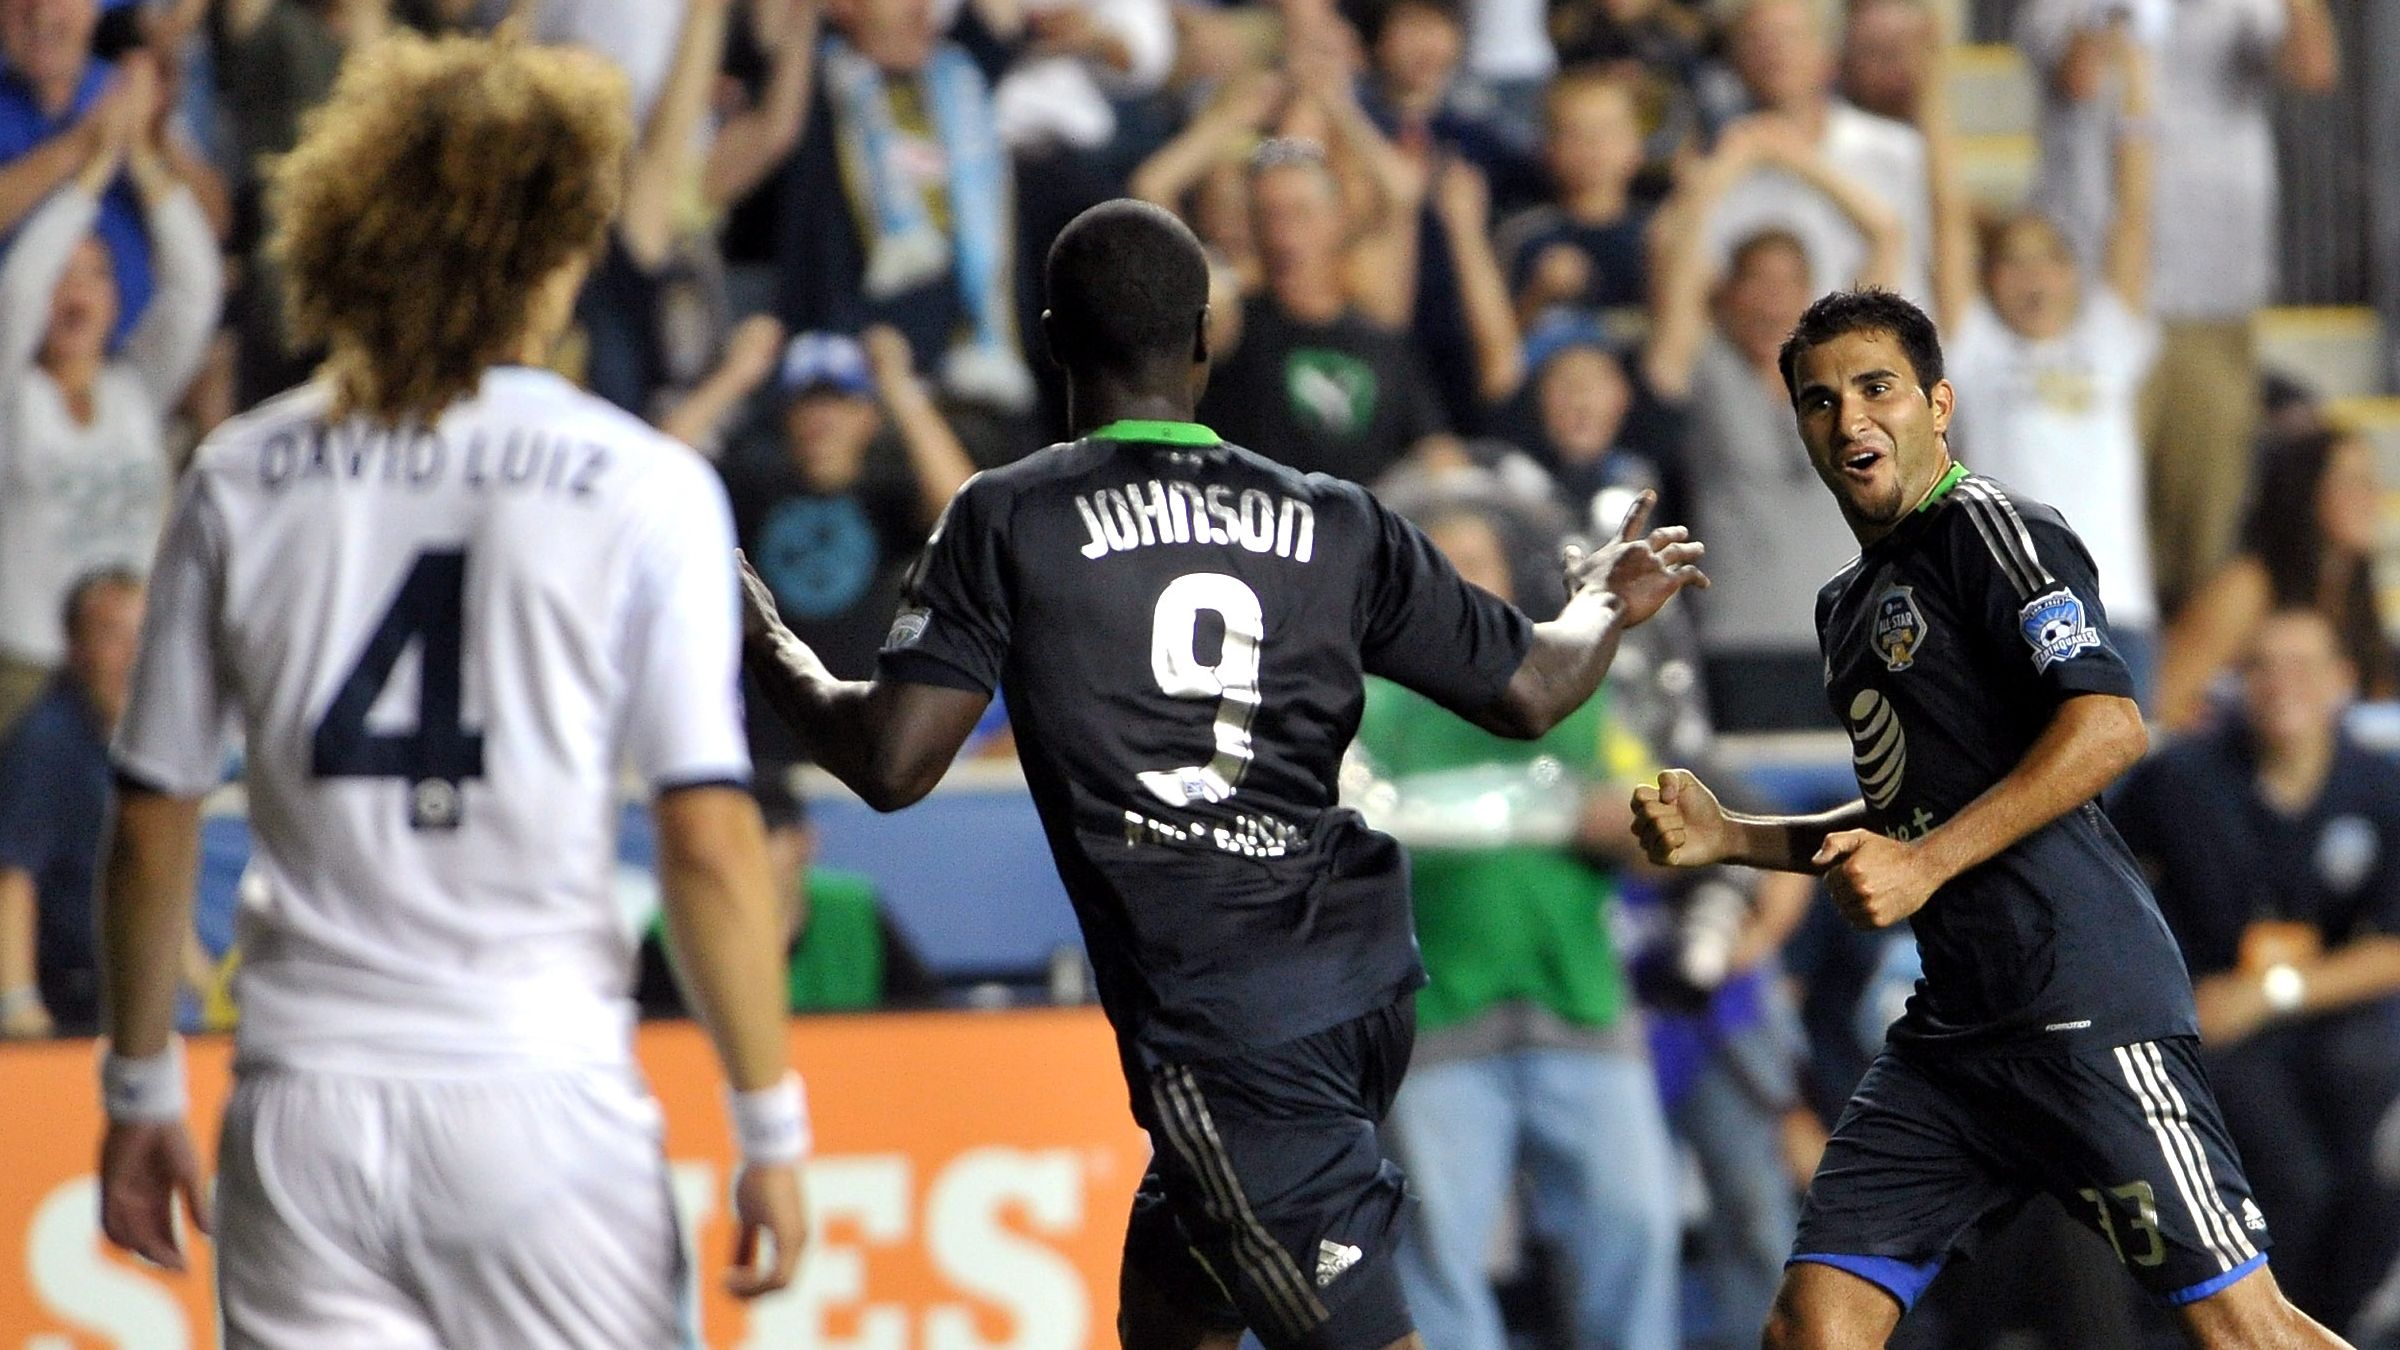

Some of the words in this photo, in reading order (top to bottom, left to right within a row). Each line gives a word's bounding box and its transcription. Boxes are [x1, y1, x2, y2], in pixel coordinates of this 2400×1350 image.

[259, 424, 447, 494] DAVID
[464, 428, 611, 498] LUIZ
[1075, 479, 1315, 563] JOHNSON
[310, 549, 484, 829] 4
[2034, 630, 2097, 664] EARTHQUAKES
[1136, 572, 1264, 808] 9
